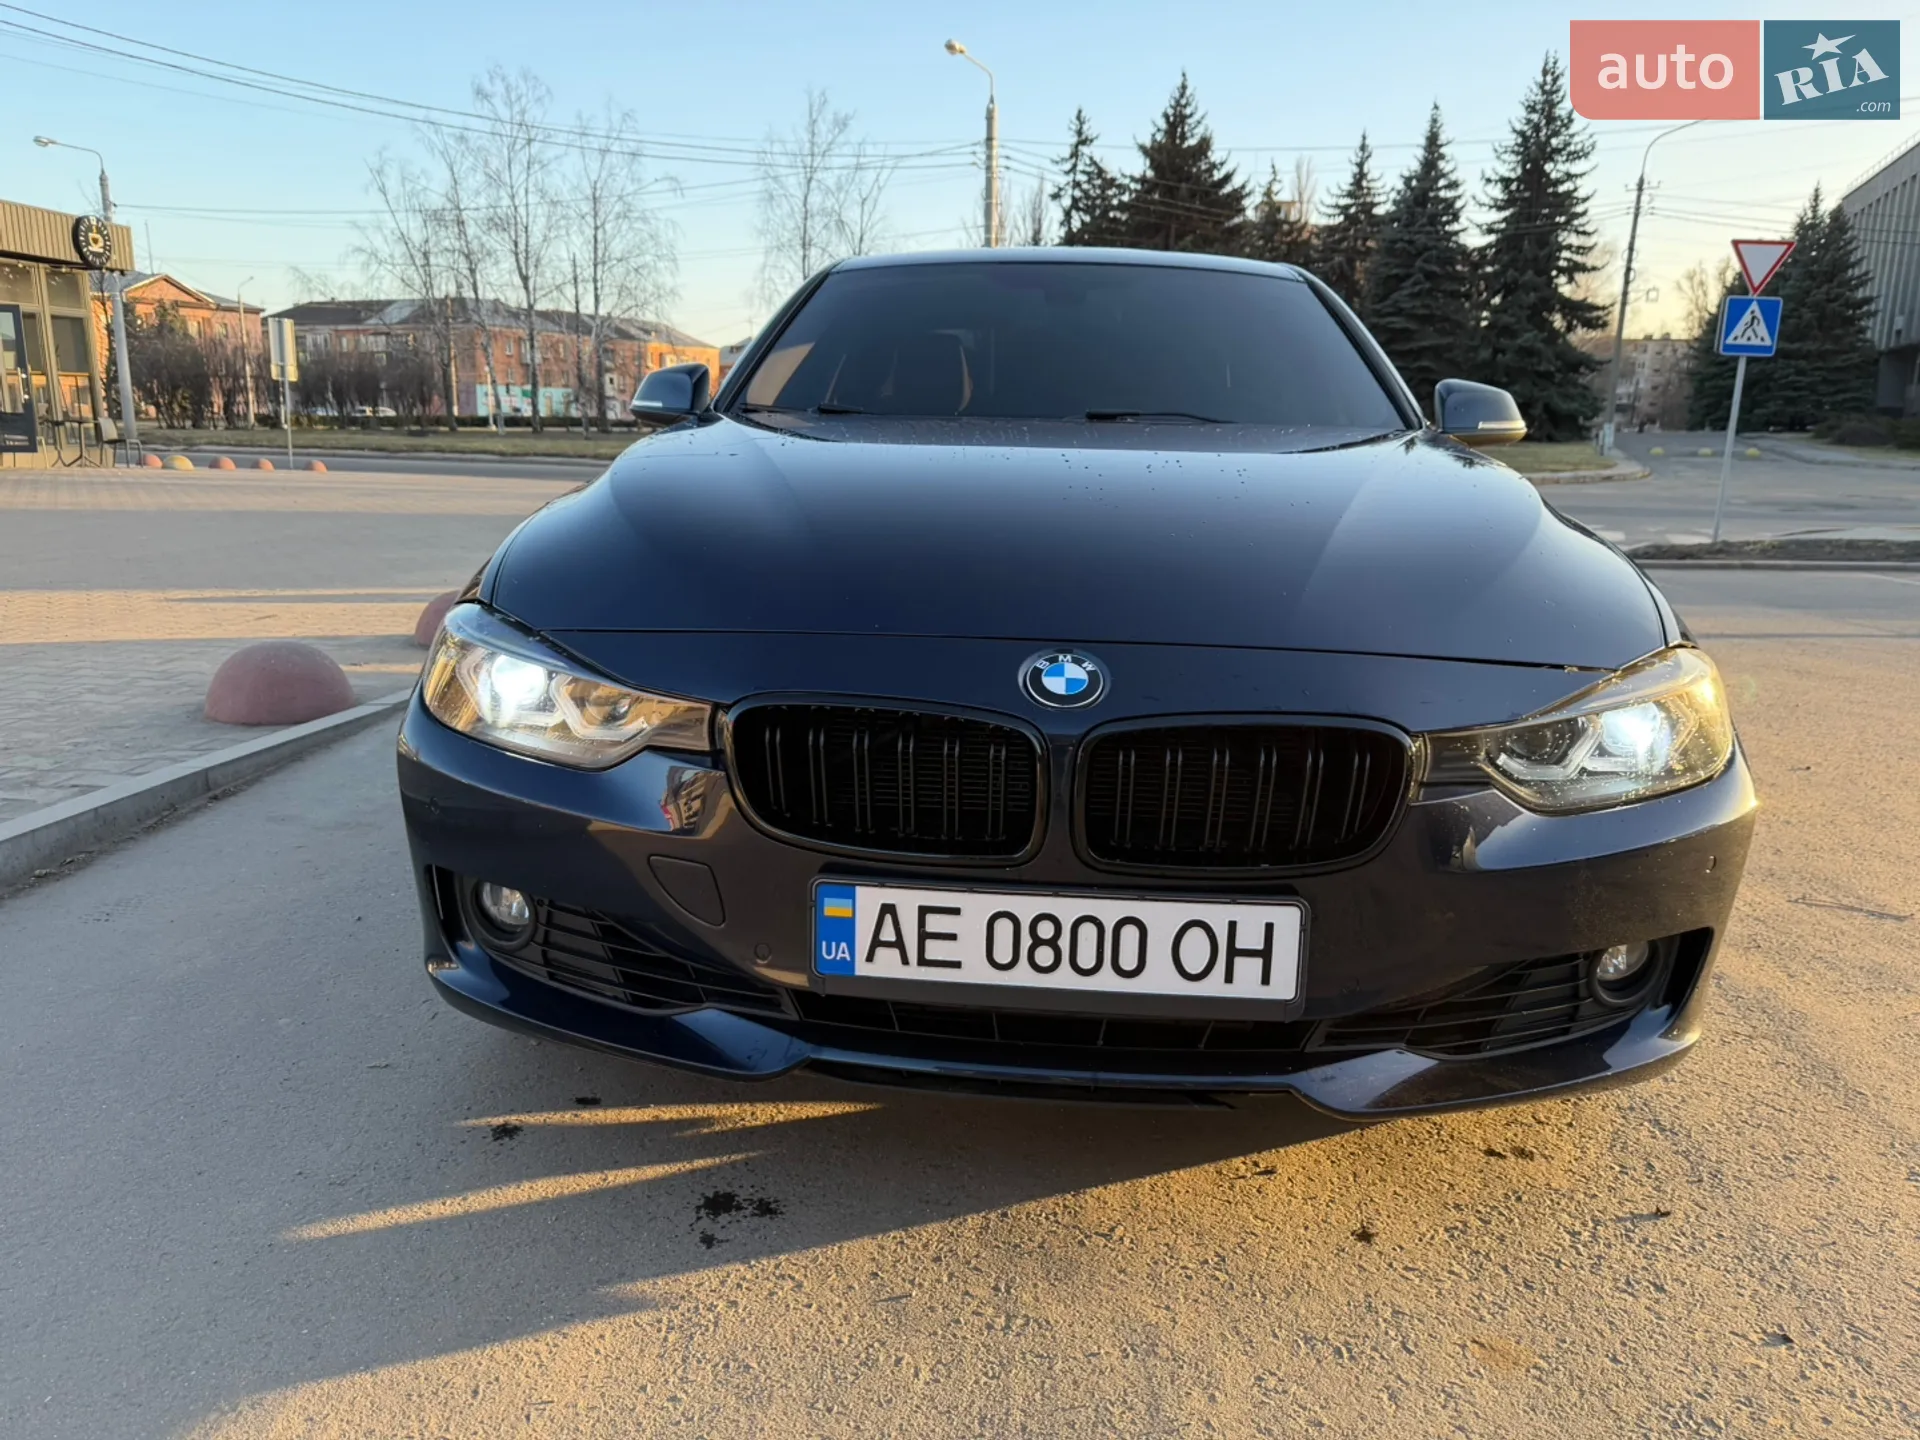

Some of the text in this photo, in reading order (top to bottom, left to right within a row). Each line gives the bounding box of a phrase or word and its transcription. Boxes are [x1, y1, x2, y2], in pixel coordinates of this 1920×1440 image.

[1035, 655, 1096, 672] BMW
[821, 940, 851, 962] UA
[864, 902, 1275, 986] AE 0800 OH
